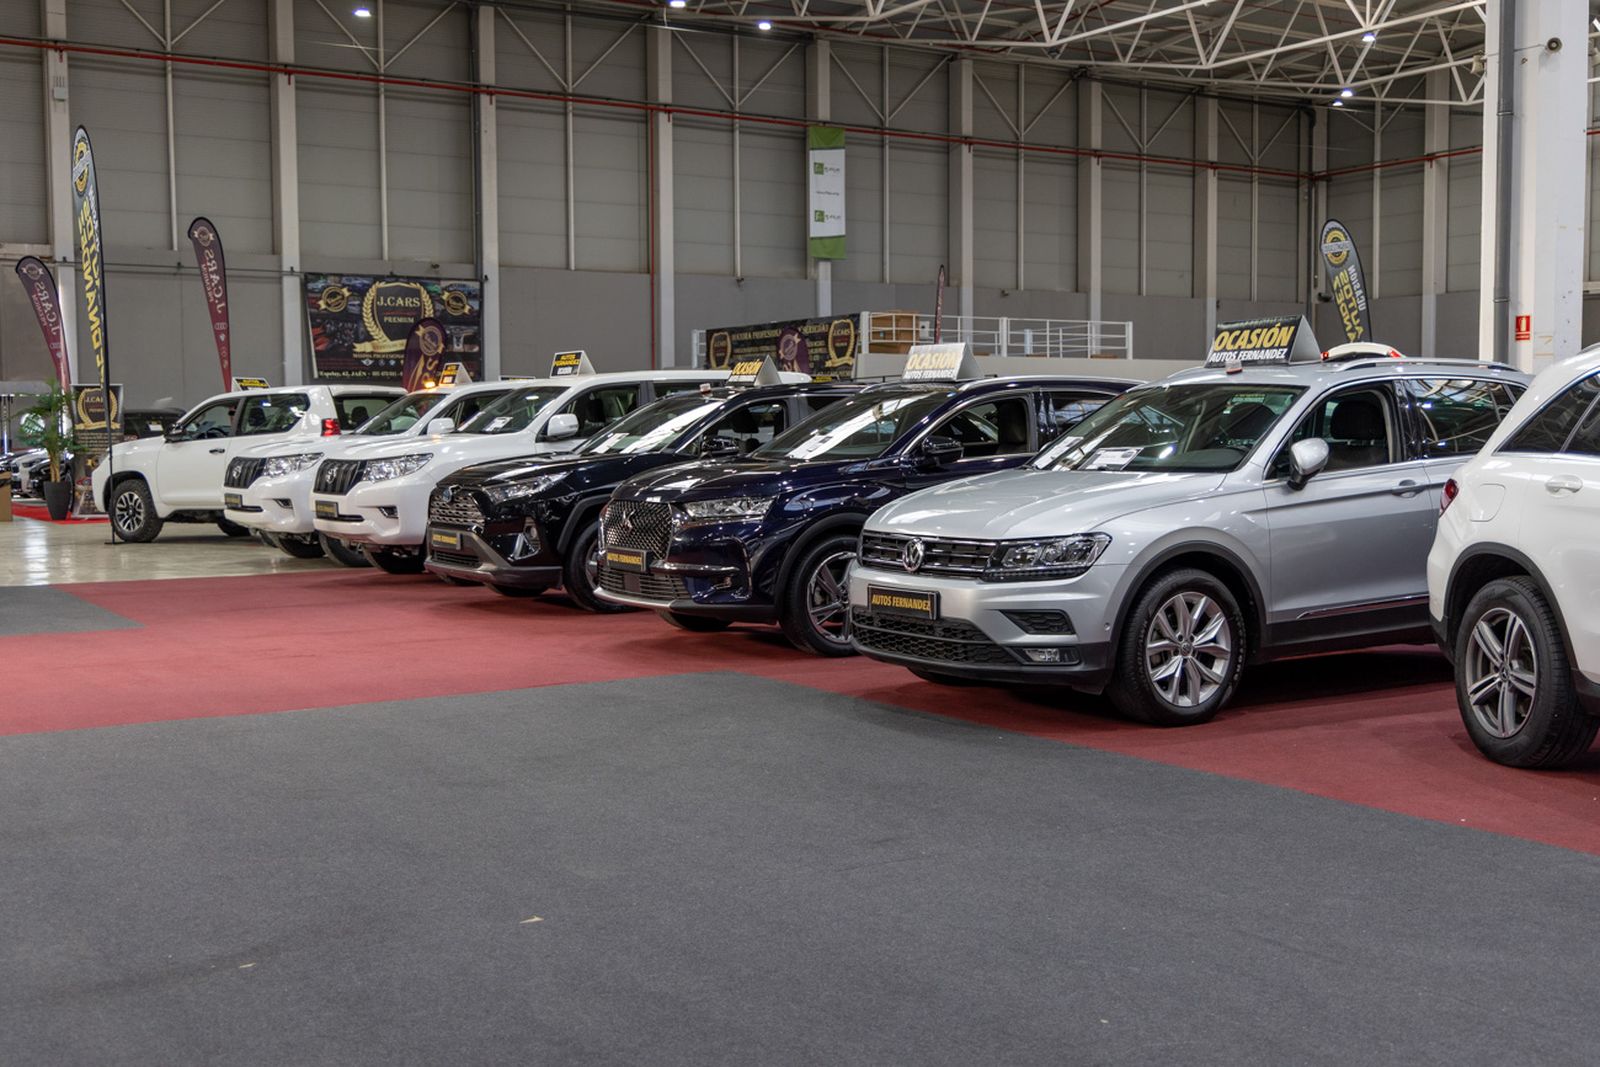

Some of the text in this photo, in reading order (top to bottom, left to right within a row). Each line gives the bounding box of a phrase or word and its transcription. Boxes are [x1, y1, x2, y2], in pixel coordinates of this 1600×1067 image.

[376, 296, 421, 308] J.CARS
[1213, 322, 1296, 352] OCASIÓN
[1209, 348, 1288, 362] AUTOS FERNANDEZ
[871, 594, 931, 612] AUTOS FERNANDEZ
